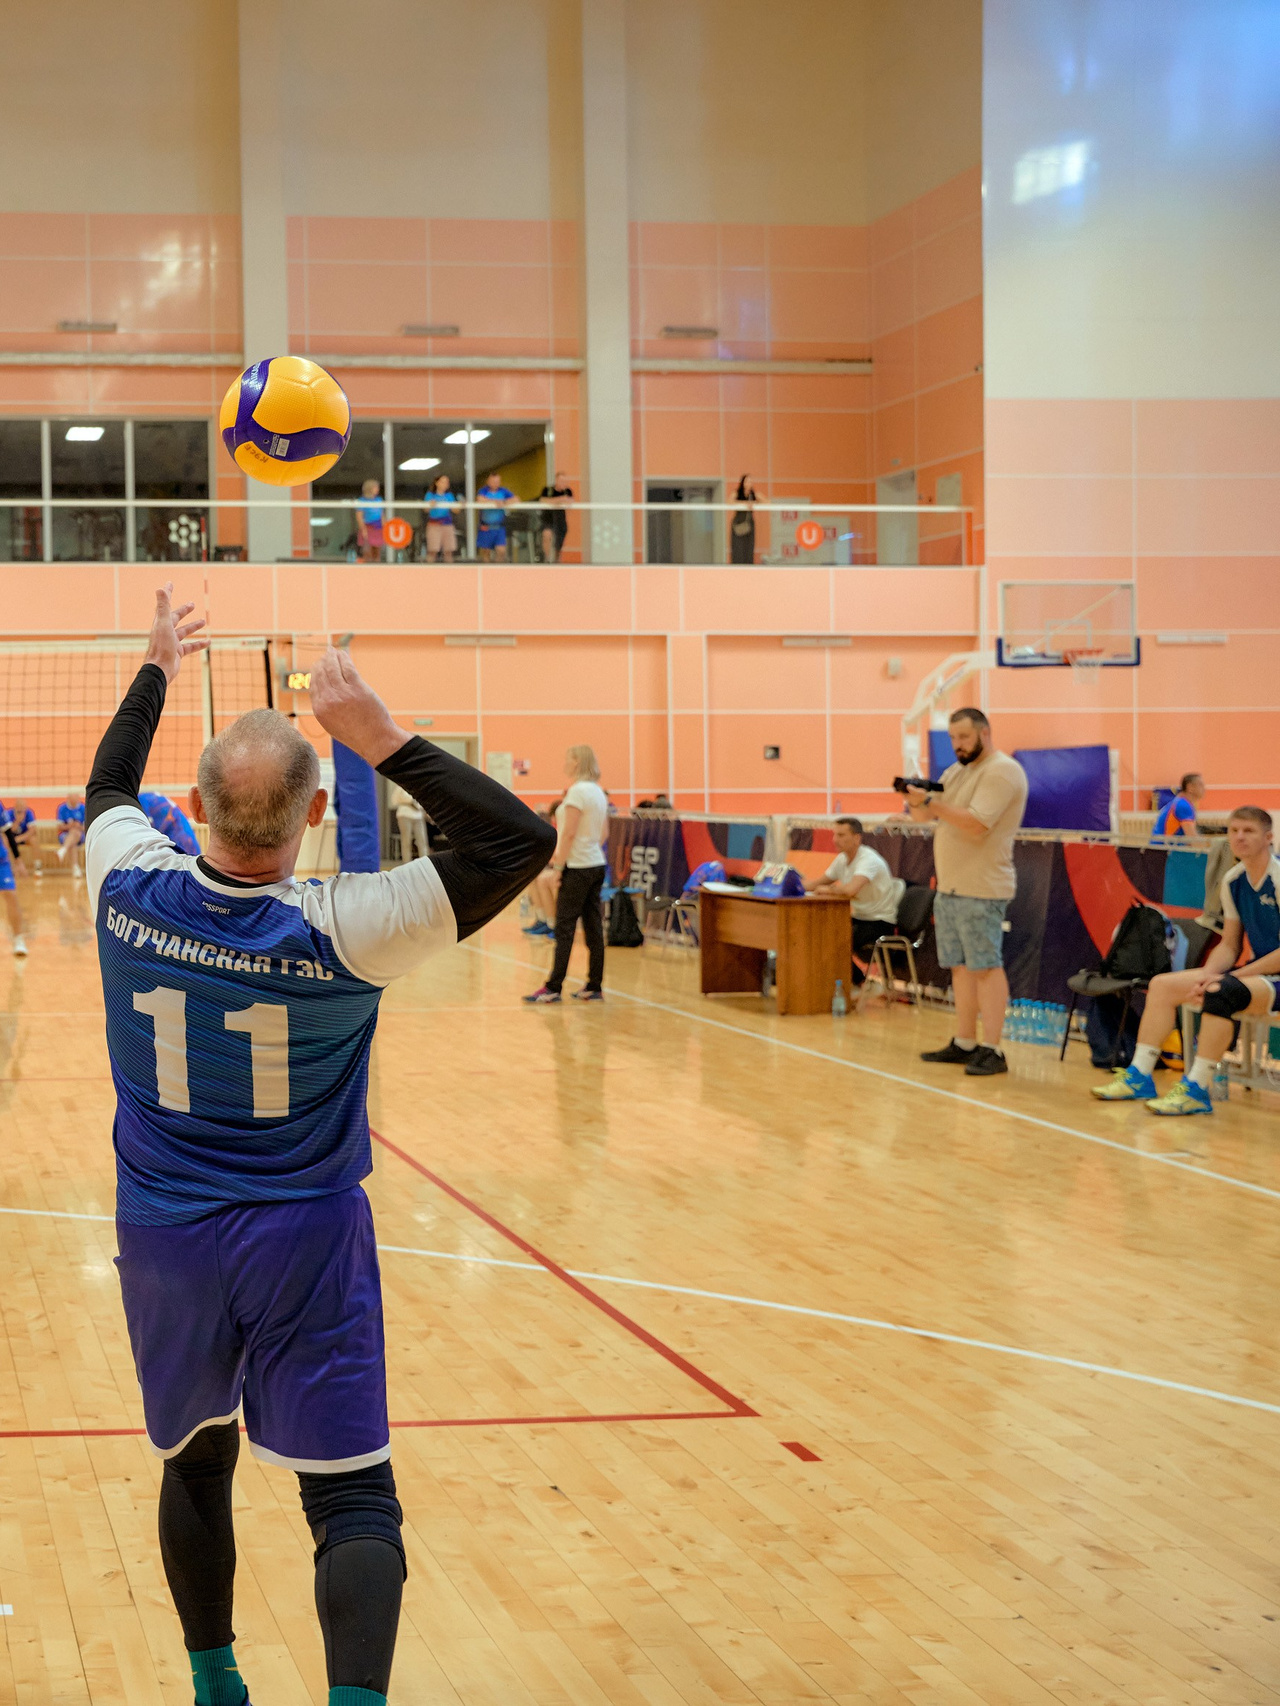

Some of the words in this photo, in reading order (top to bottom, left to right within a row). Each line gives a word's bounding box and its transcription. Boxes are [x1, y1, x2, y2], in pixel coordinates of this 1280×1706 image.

[389, 525, 406, 543] U
[802, 527, 818, 545] U
[106, 905, 271, 974] БОГУЧАНСКАЯ
[280, 958, 334, 981] ГЭС
[133, 985, 290, 1118] 11
